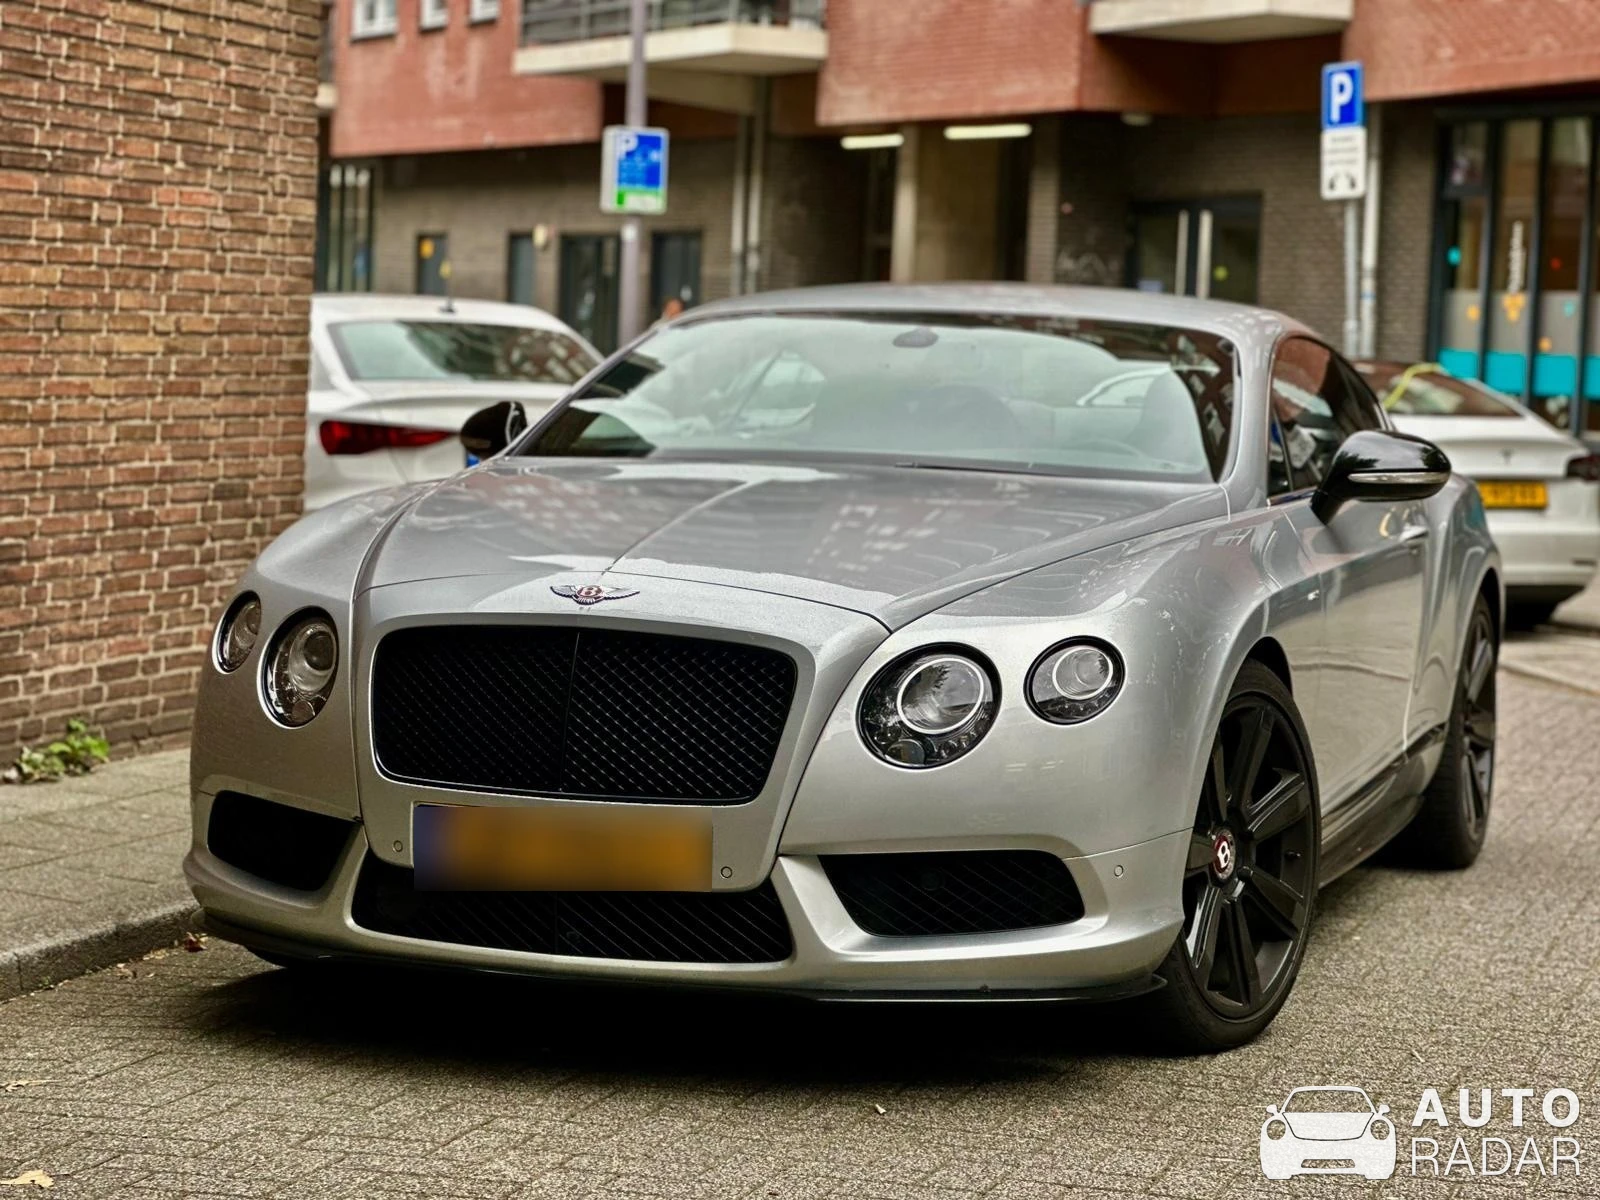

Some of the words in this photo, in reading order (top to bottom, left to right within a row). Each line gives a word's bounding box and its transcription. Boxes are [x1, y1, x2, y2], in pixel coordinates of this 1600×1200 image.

[1330, 71, 1353, 123] P
[617, 135, 638, 159] P
[1217, 841, 1231, 868] B
